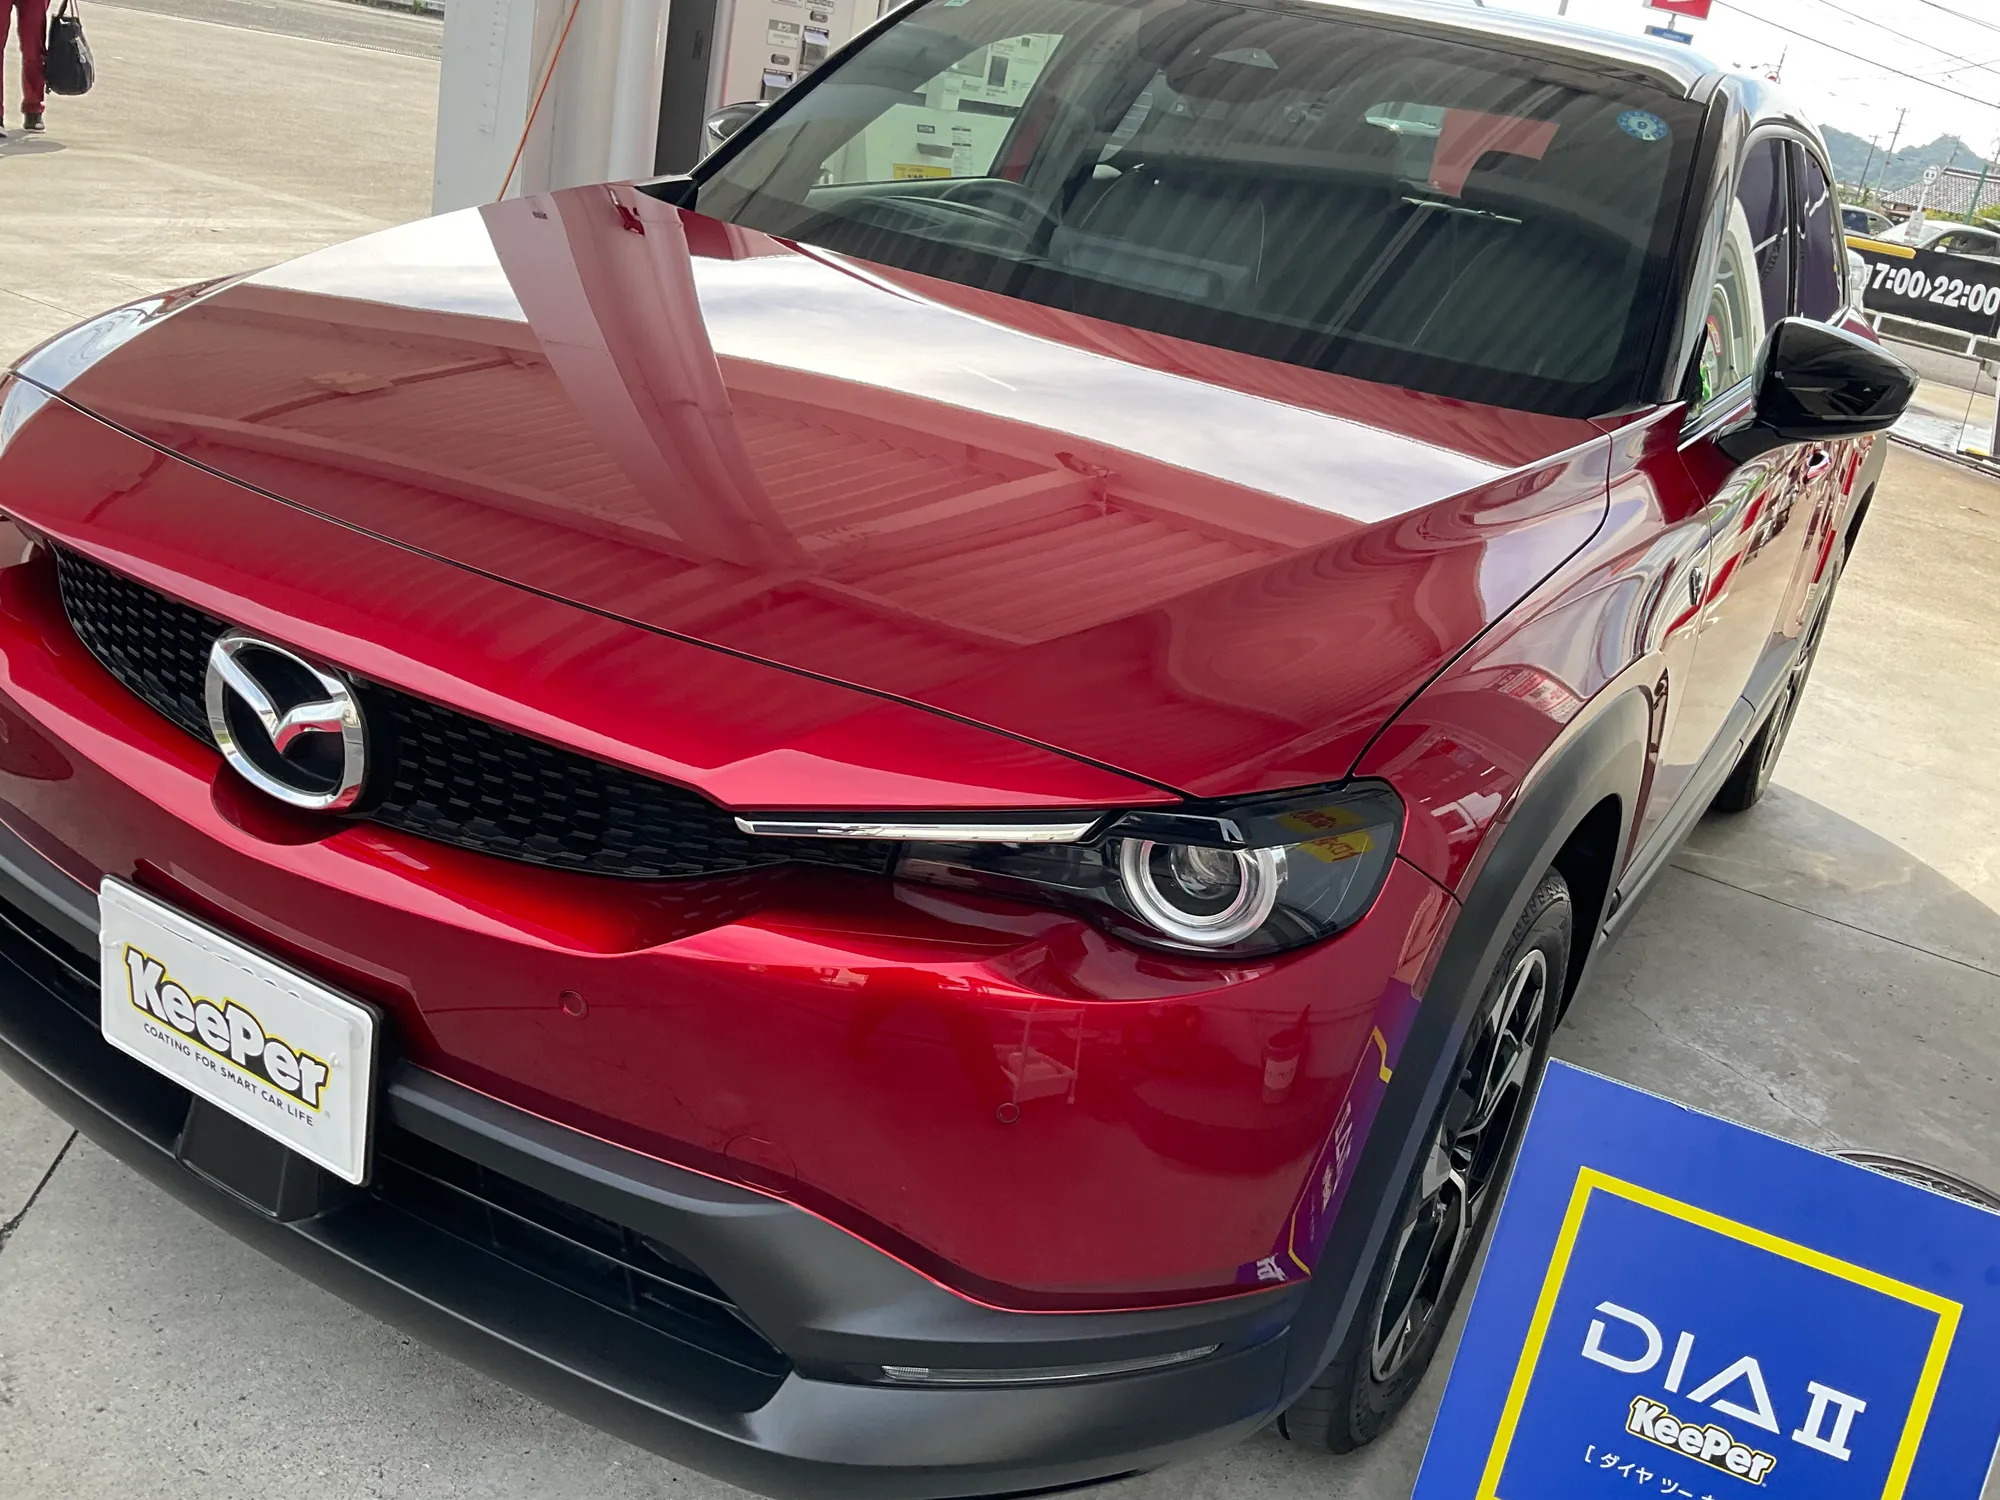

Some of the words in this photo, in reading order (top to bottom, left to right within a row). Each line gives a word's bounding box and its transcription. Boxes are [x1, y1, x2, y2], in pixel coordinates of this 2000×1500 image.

[124, 945, 329, 1109] KeePer
[143, 1022, 191, 1057] COATING
[195, 1051, 217, 1072] FOR
[220, 1066, 257, 1095] SMART
[261, 1089, 284, 1110] CAR
[287, 1104, 314, 1127] LIFE
[1581, 1301, 1780, 1434] DIA
[1627, 1396, 1776, 1484] KeePer
